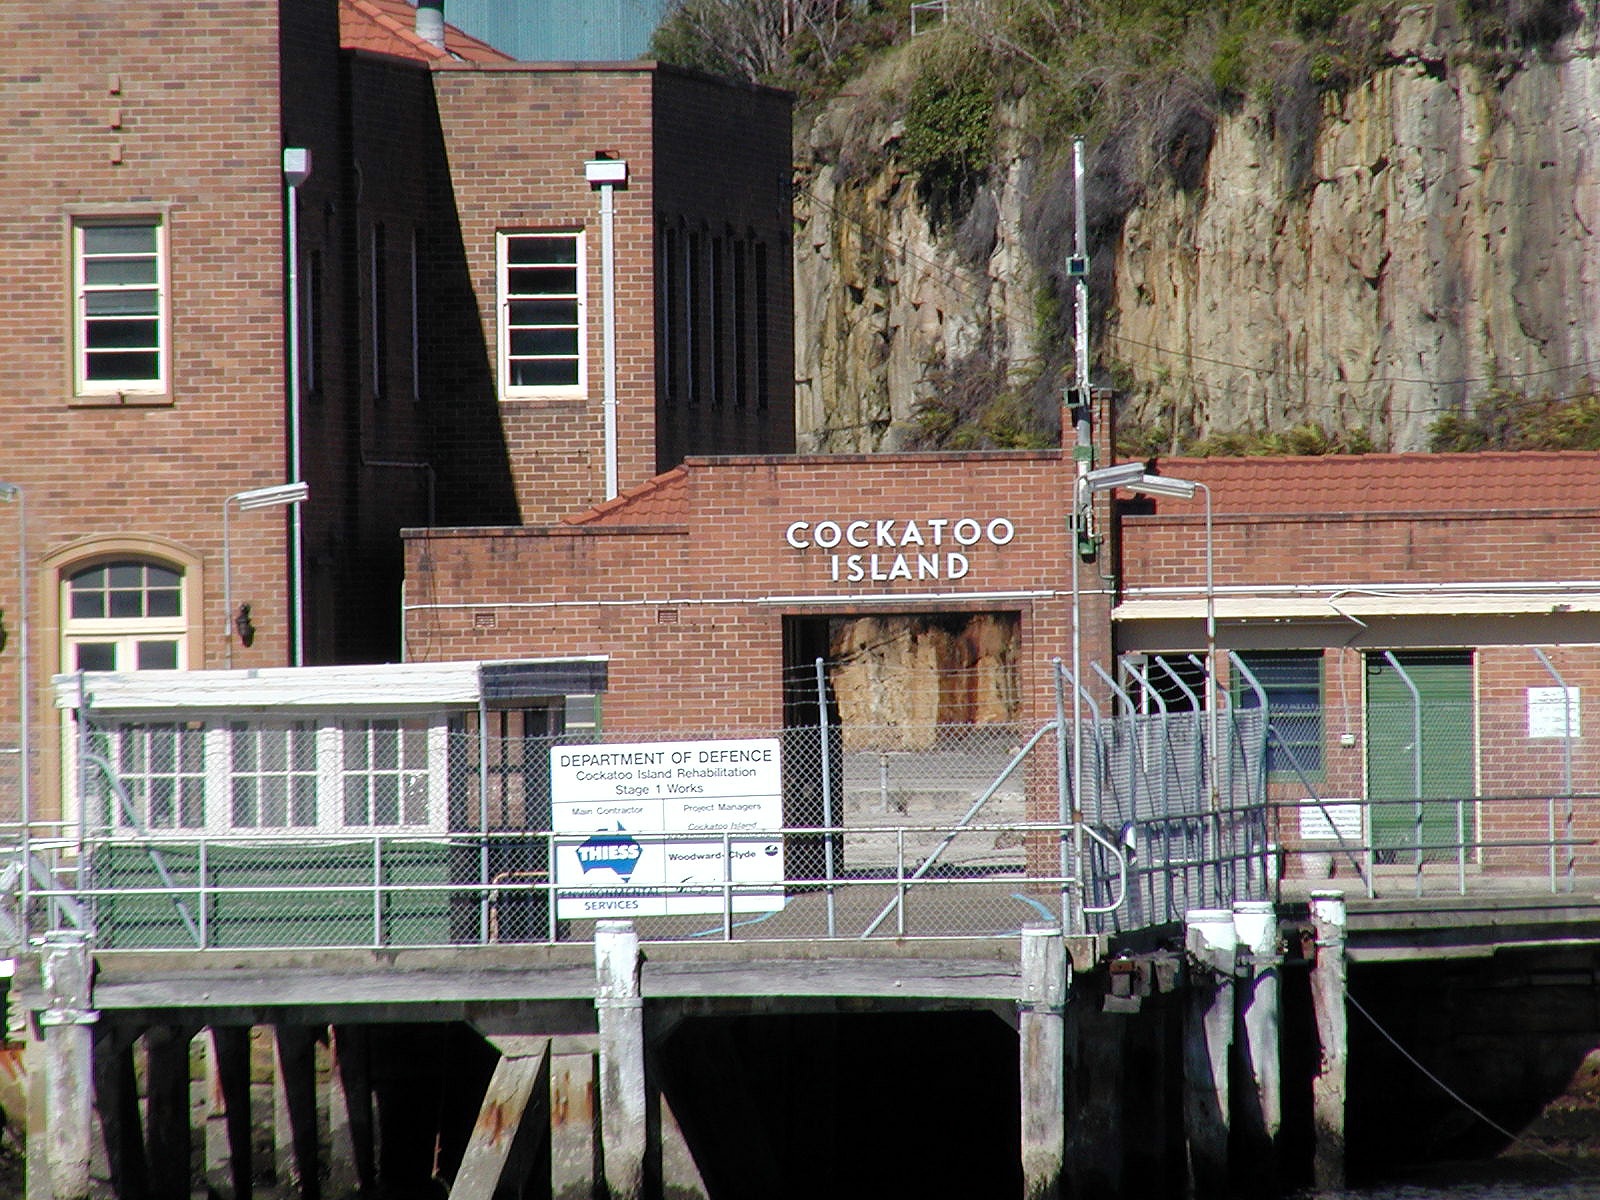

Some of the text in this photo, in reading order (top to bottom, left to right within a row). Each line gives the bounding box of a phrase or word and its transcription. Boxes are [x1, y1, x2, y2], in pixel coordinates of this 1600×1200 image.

[786, 518, 1015, 549] COCKATOO
[831, 552, 969, 582] ISLAND
[560, 749, 772, 767] DEPARTMENT OF DEFENCE
[576, 767, 757, 781] Cockatoo Island Rehabilitation
[615, 783, 704, 797] Stage 1 Works
[572, 806, 644, 816] Main Contractor
[683, 803, 762, 813] Project Managers
[579, 843, 640, 862] THIESS
[584, 900, 639, 911] SERVICES
